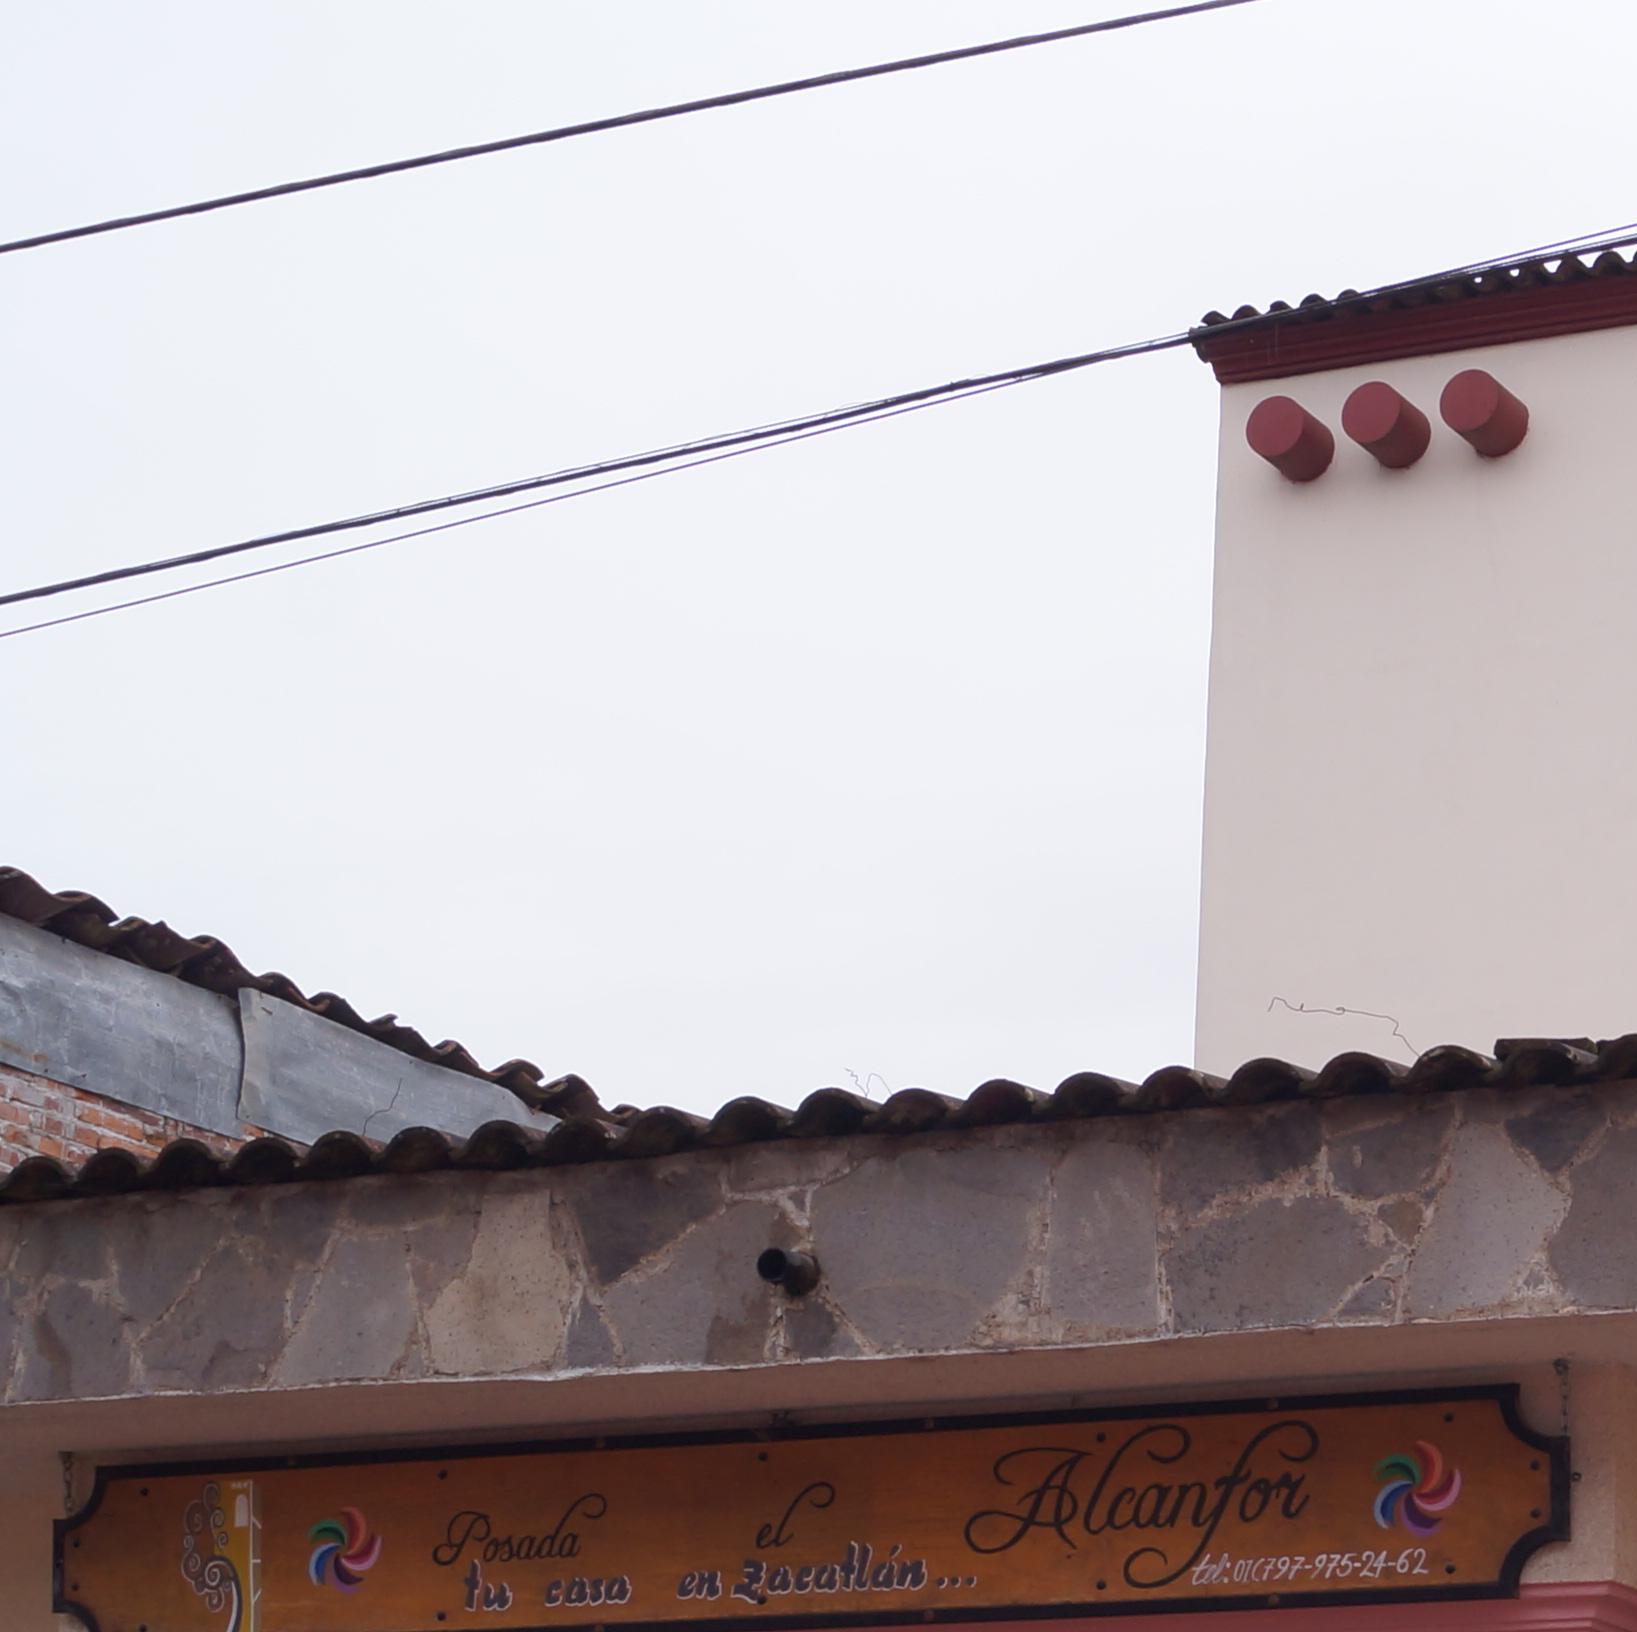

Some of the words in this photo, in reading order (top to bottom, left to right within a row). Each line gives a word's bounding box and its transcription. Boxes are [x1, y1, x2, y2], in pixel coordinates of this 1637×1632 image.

[433, 1493, 608, 1567] Posada
[756, 1482, 836, 1549] el
[964, 1420, 1319, 1589] Alcanfor
[464, 1558, 514, 1613] tu
[544, 1570, 632, 1608] casa
[677, 1568, 723, 1601] en
